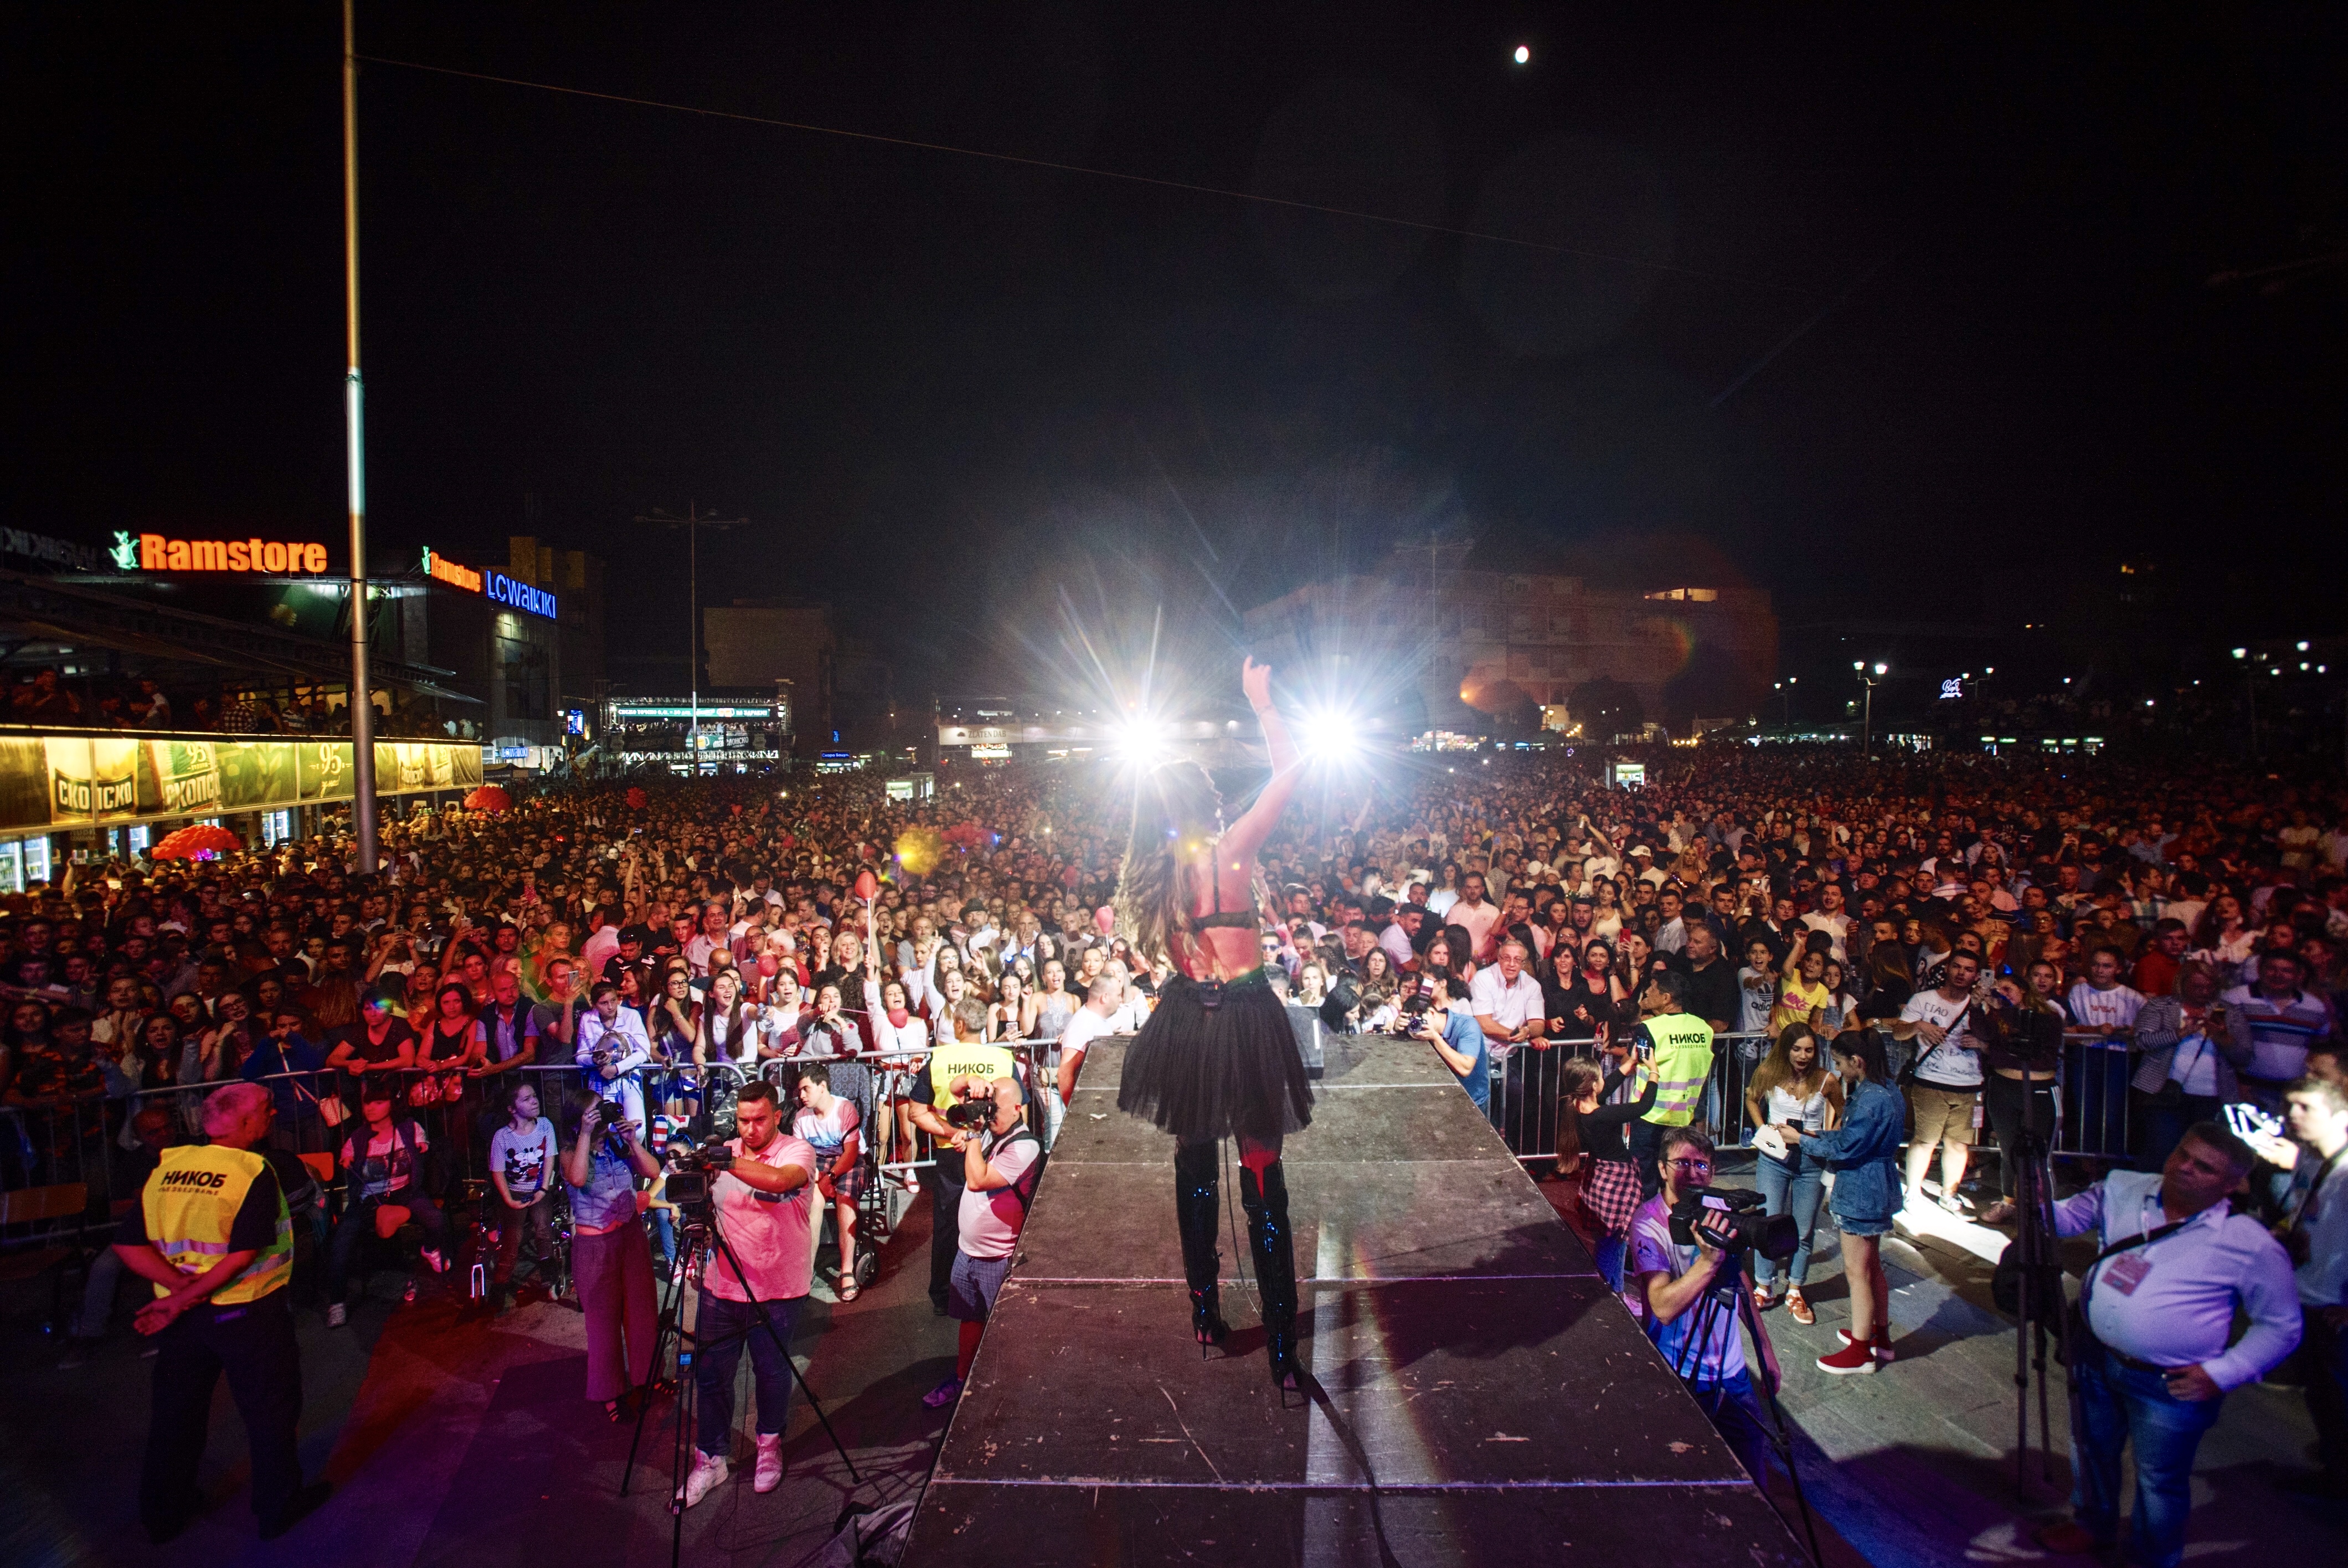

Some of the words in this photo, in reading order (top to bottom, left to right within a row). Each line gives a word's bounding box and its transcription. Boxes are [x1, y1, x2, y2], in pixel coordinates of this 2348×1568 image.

[141, 534, 327, 572] Ramstore
[430, 551, 481, 592] Ramstore
[187, 742, 207, 764] 95
[319, 742, 342, 775] 95
[1784, 992, 1810, 1012] NIKE
[1924, 1002, 1948, 1017] CIAO
[1669, 1033, 1706, 1045] НИКОБ
[948, 1064, 994, 1074] НИКОБ
[161, 1171, 226, 1188] НИКОБ
